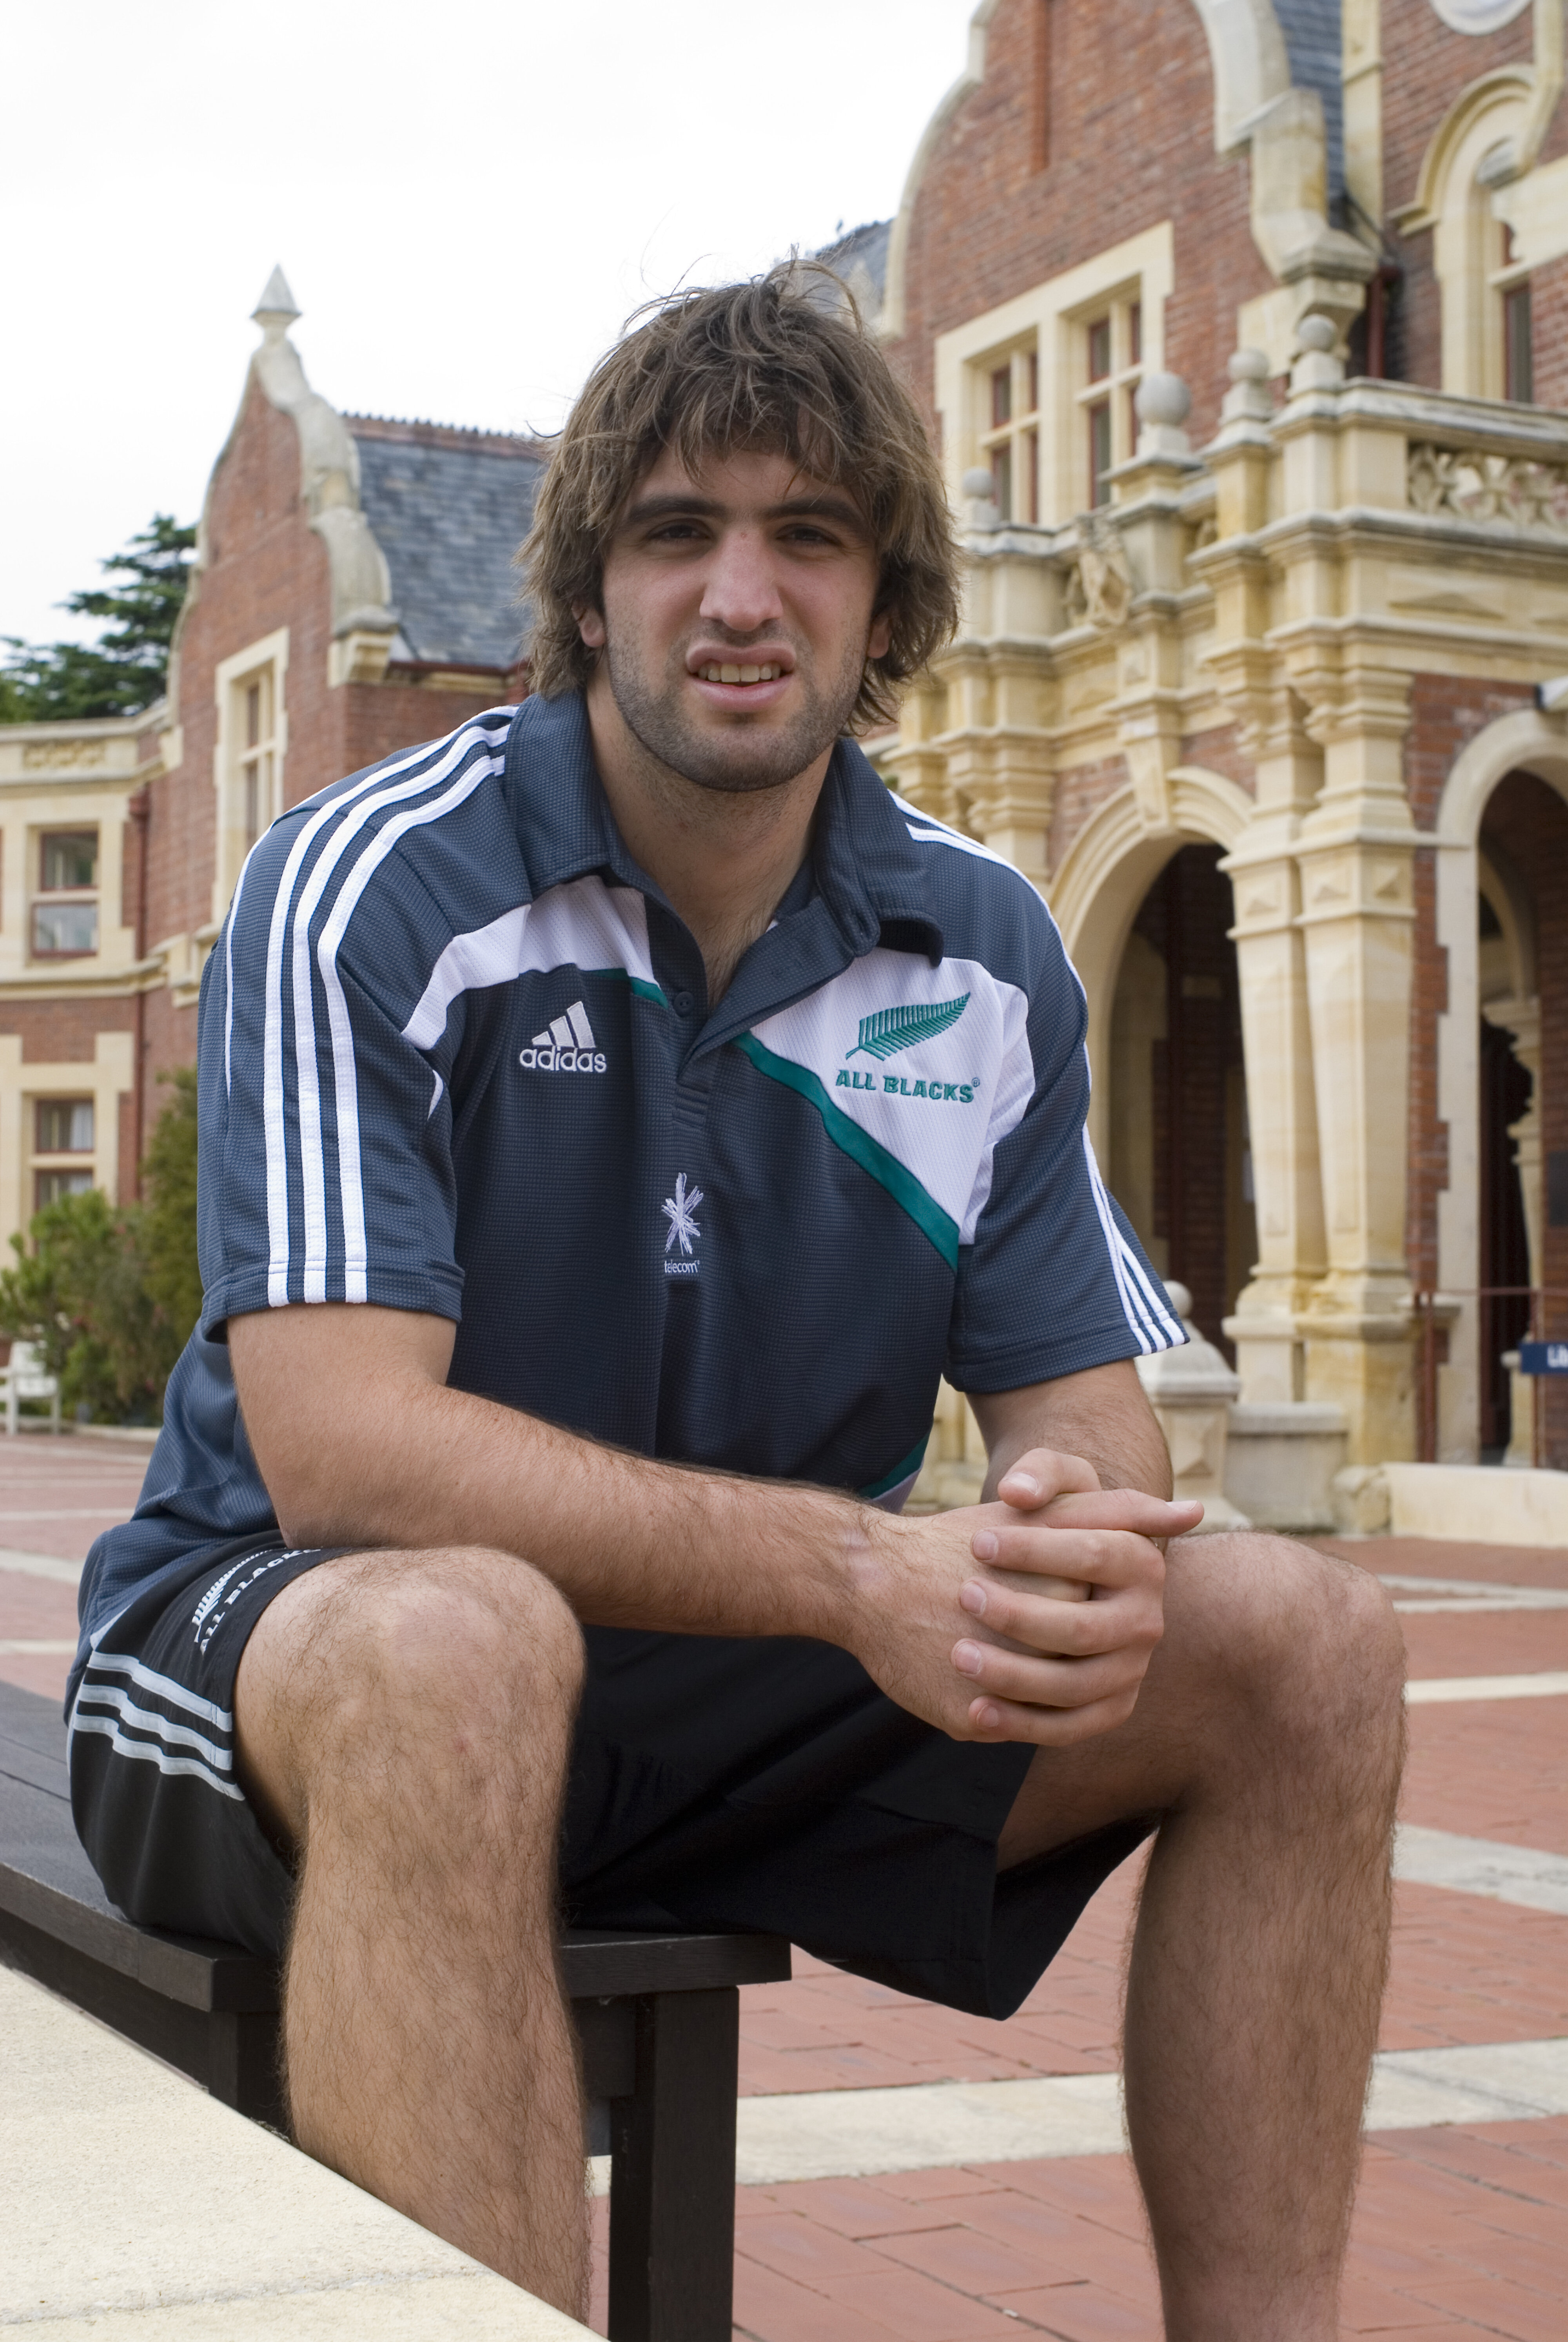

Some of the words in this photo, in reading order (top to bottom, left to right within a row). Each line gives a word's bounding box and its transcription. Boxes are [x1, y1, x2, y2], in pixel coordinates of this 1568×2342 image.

[519, 1045, 607, 1073] adidas
[835, 1069, 876, 1090] ALL
[664, 1259, 698, 1273] telecom
[200, 1612, 225, 1656] ALL
